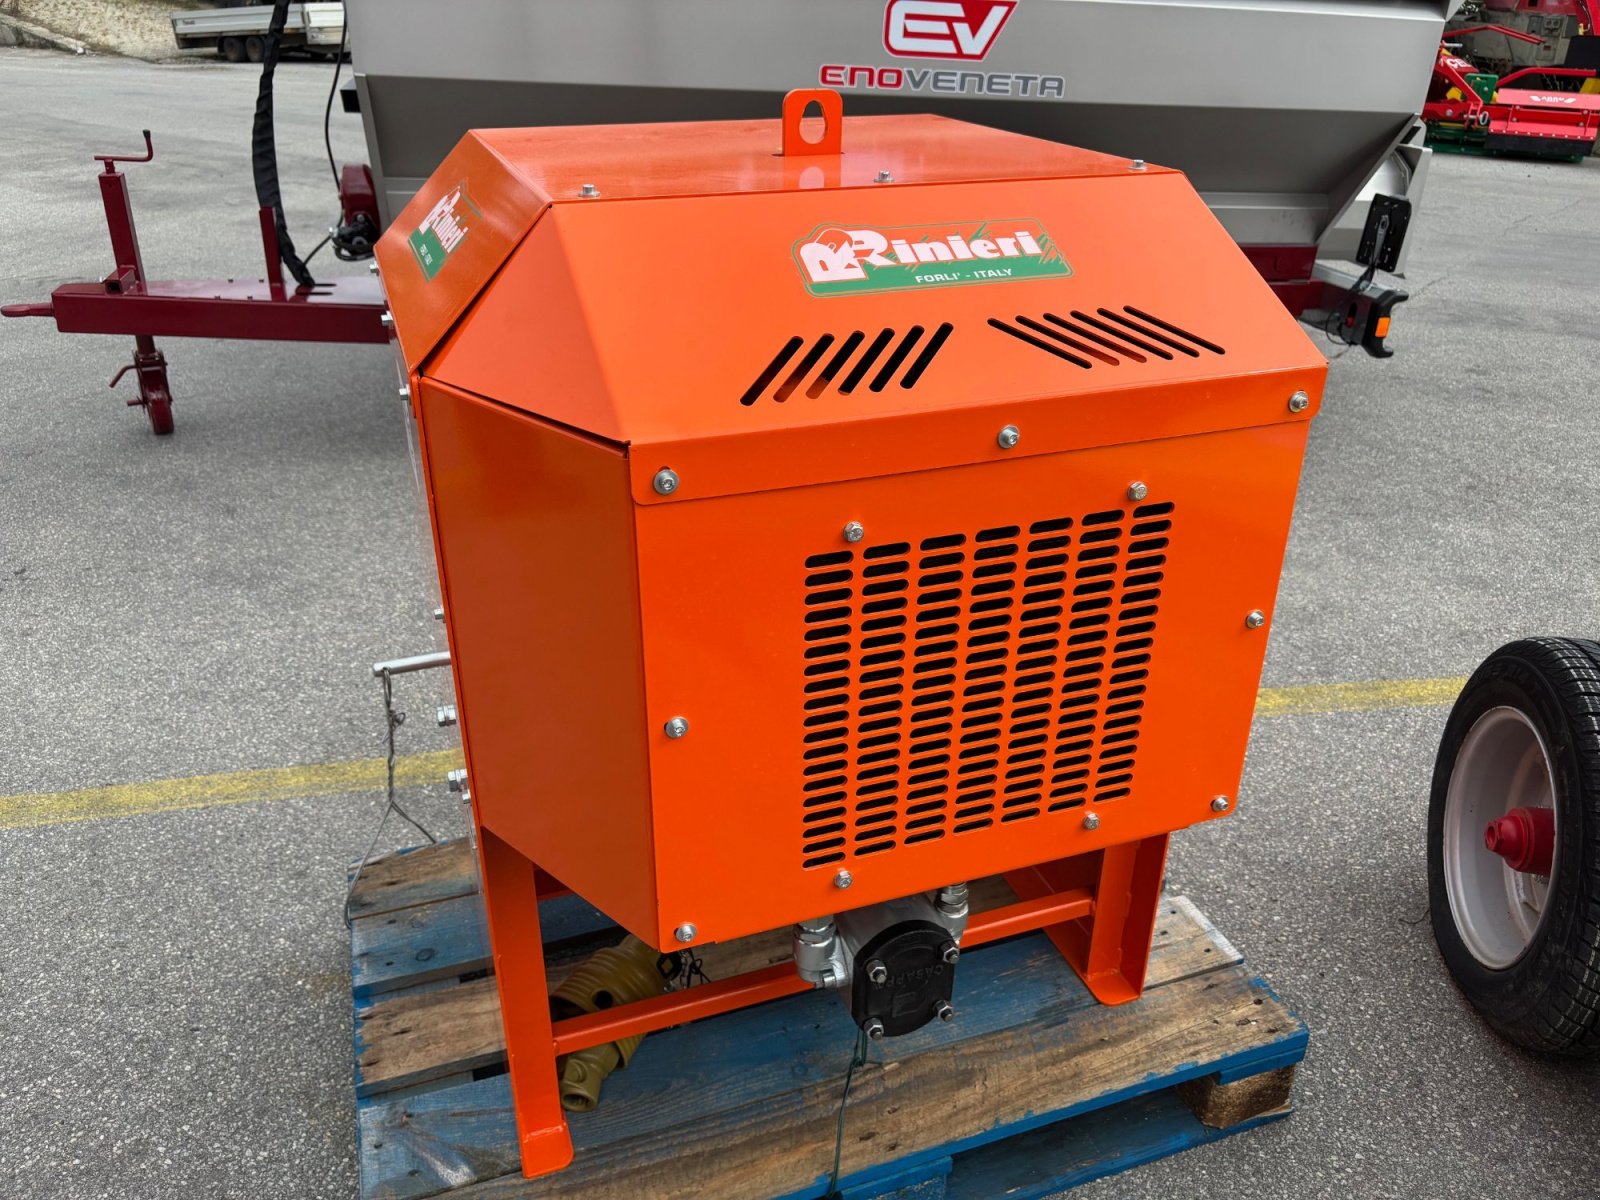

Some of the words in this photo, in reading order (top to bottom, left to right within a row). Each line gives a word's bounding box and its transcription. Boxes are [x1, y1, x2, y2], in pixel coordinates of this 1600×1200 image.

[888, 0, 1009, 55] EV
[819, 64, 1064, 97] ENOVENETA
[846, 230, 1042, 267] Rinieri
[974, 268, 1013, 279] ITALY
